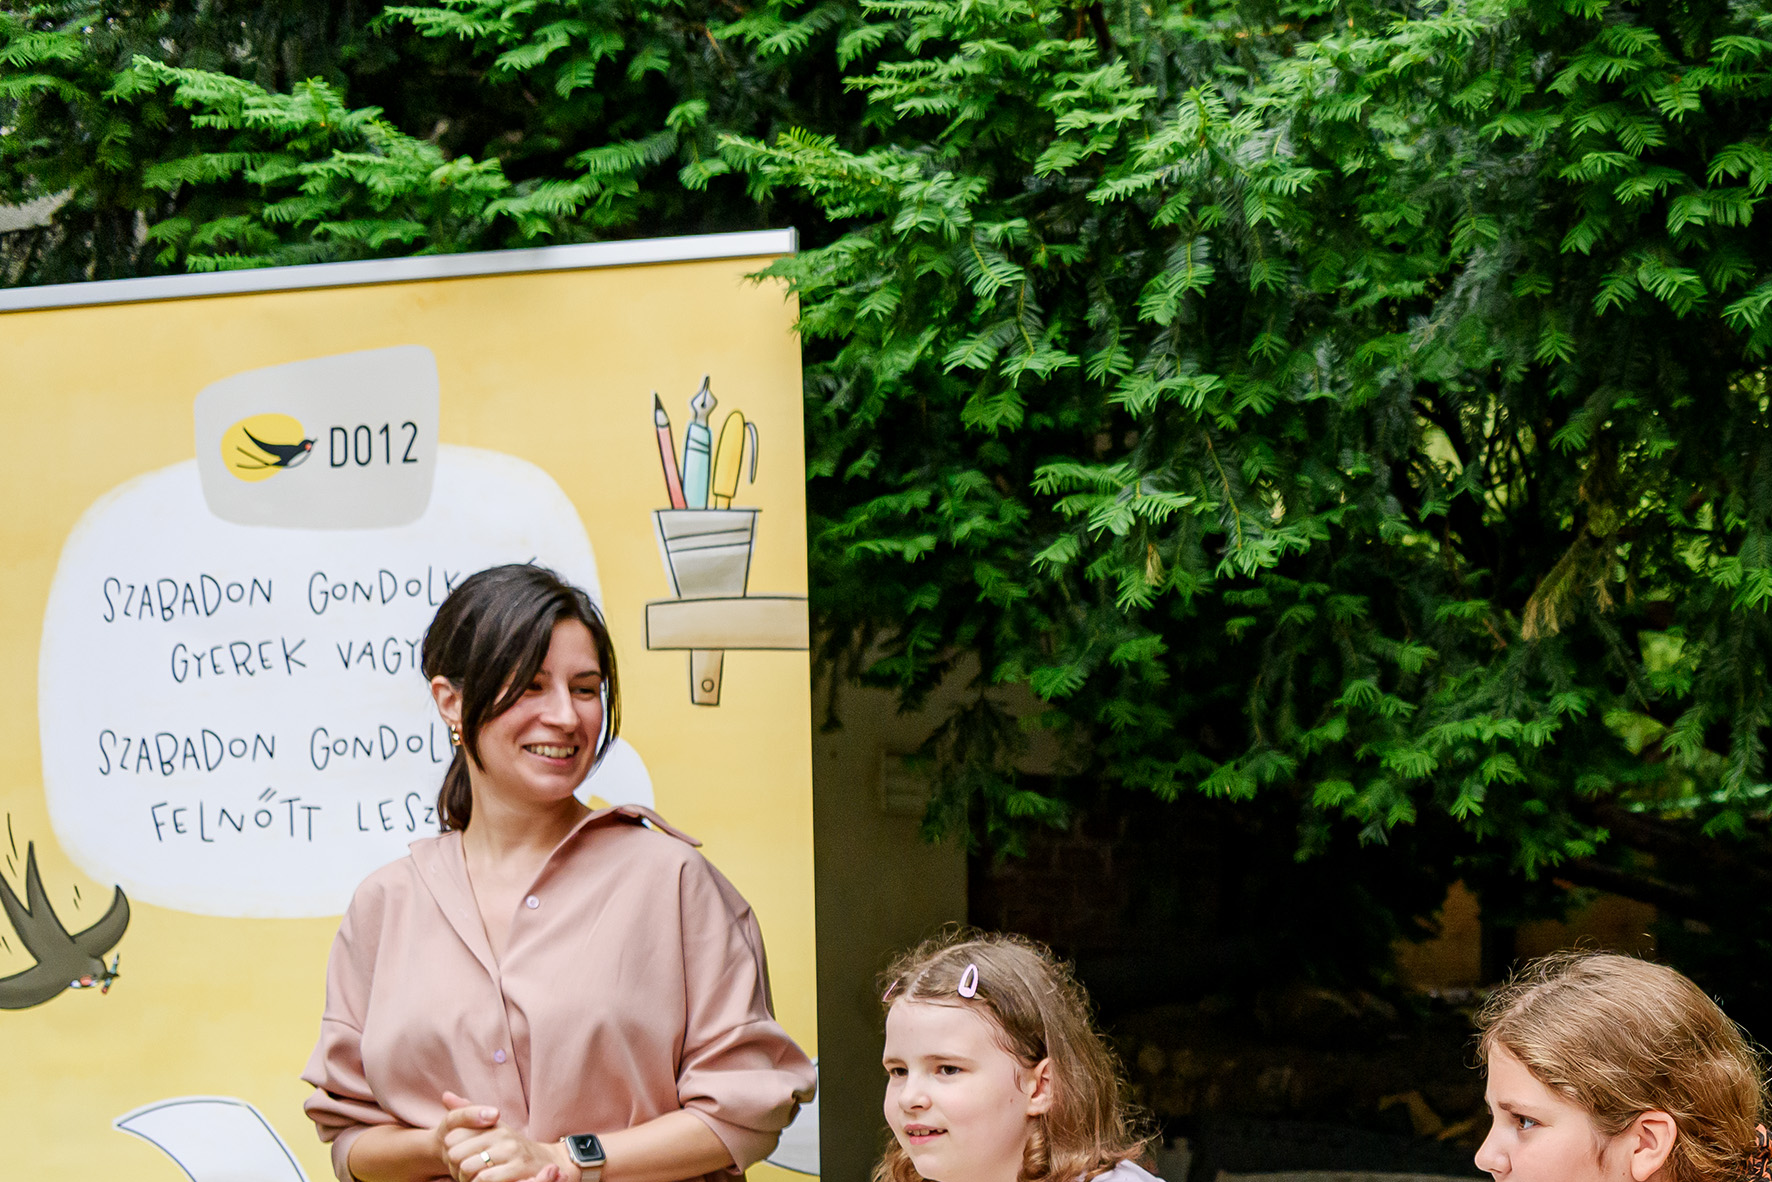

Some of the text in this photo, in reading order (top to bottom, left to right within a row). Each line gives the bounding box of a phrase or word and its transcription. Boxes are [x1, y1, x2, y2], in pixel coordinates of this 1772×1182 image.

[103, 573, 272, 622] SZABADON
[171, 636, 306, 684] GYEREK
[99, 722, 456, 776] SZABADON GONDOL
[151, 786, 322, 842] FELNŐTT
